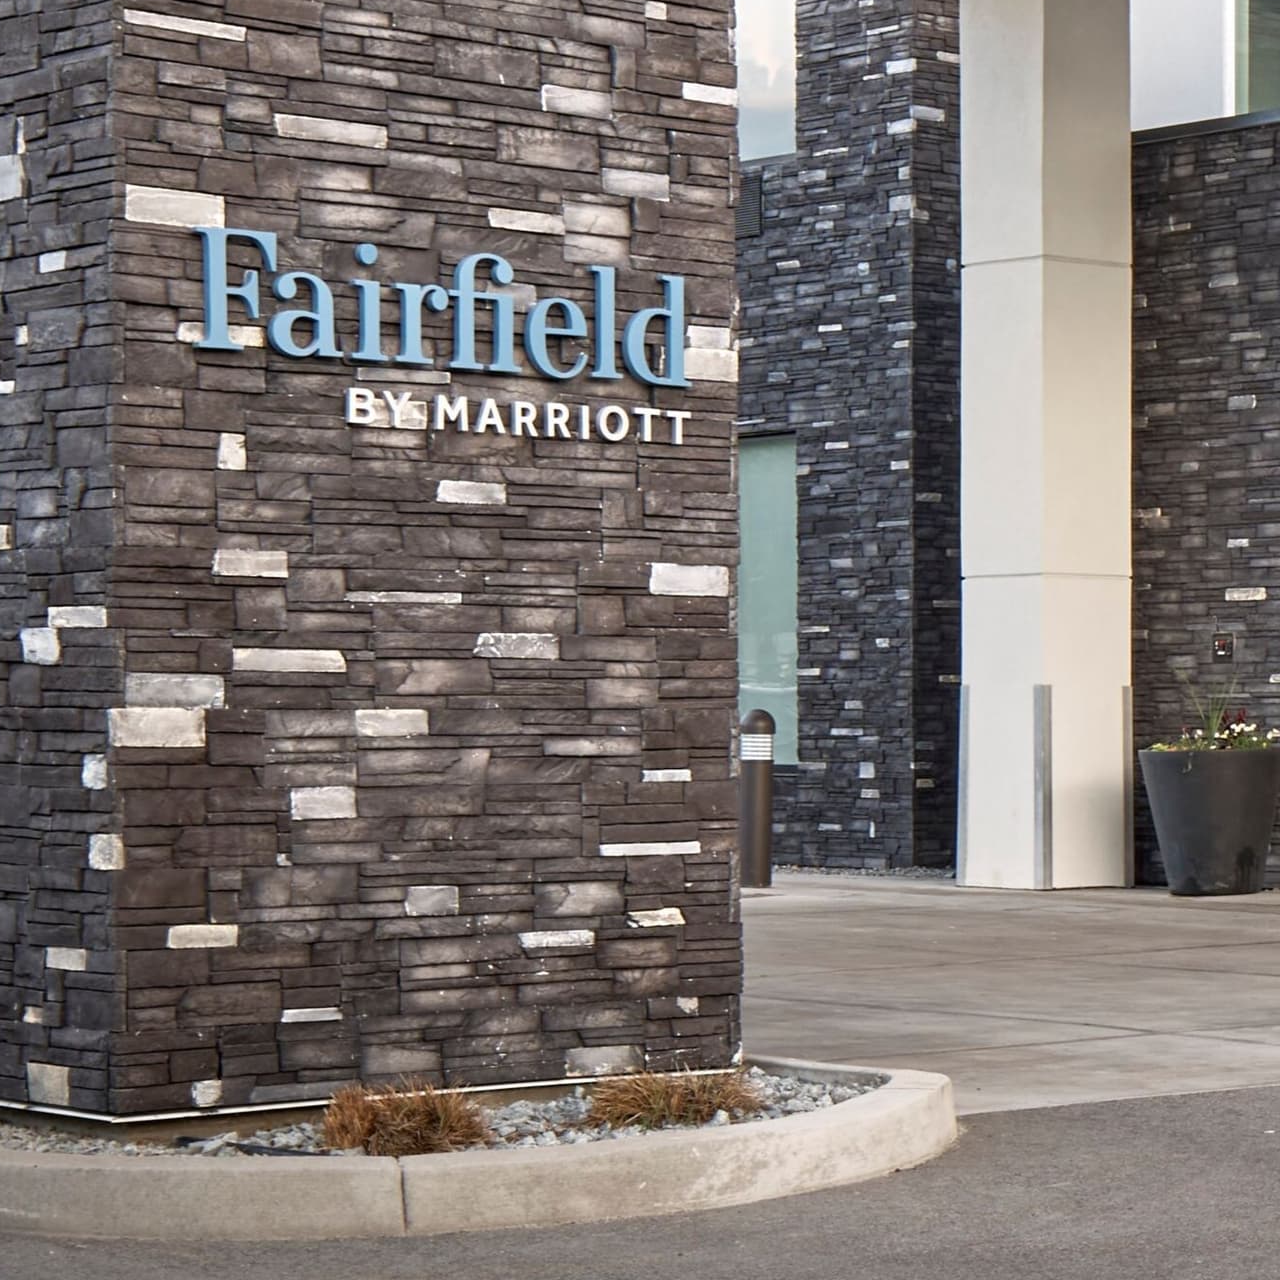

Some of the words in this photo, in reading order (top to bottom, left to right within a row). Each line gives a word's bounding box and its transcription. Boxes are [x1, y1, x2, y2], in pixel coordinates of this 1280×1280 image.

[193, 226, 692, 388] Fairfield
[345, 387, 412, 429] BY
[433, 394, 692, 444] MARRIOTT
